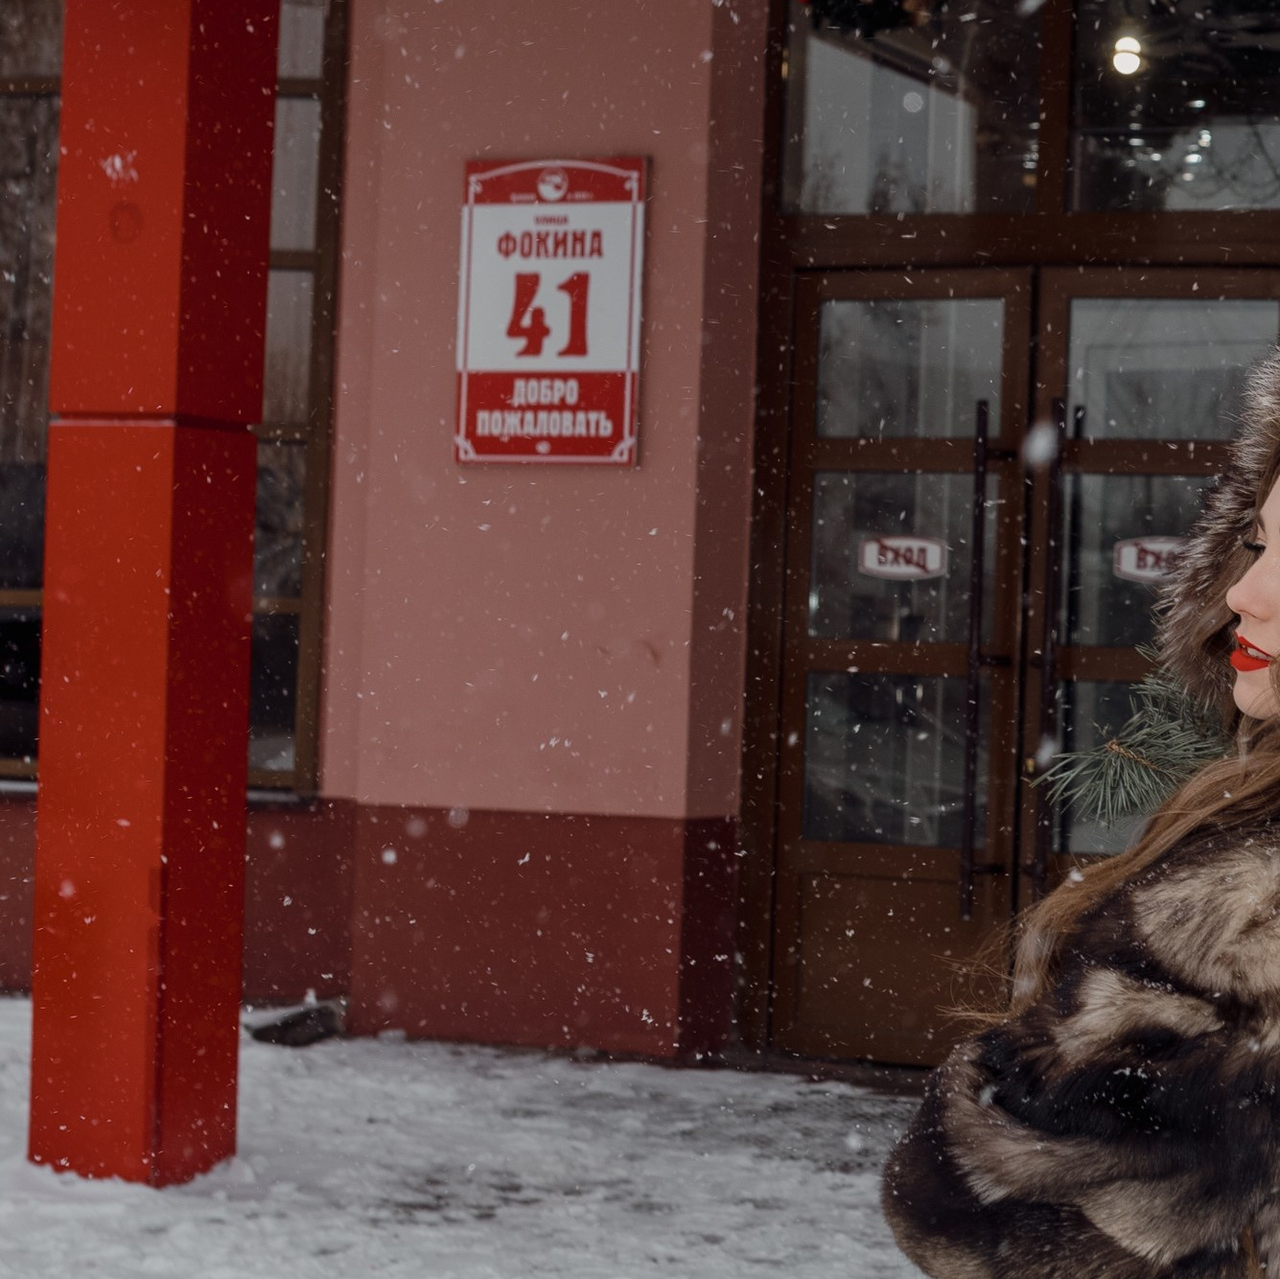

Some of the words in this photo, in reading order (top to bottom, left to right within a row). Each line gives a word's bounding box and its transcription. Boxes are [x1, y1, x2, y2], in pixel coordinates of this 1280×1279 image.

[497, 229, 603, 259] ФОКИНА
[506, 271, 590, 357] 41
[512, 378, 579, 406] ДОБРО
[476, 410, 613, 438] ПОЖАЛОВАТЬ
[1137, 548, 1178, 570] ВХО
